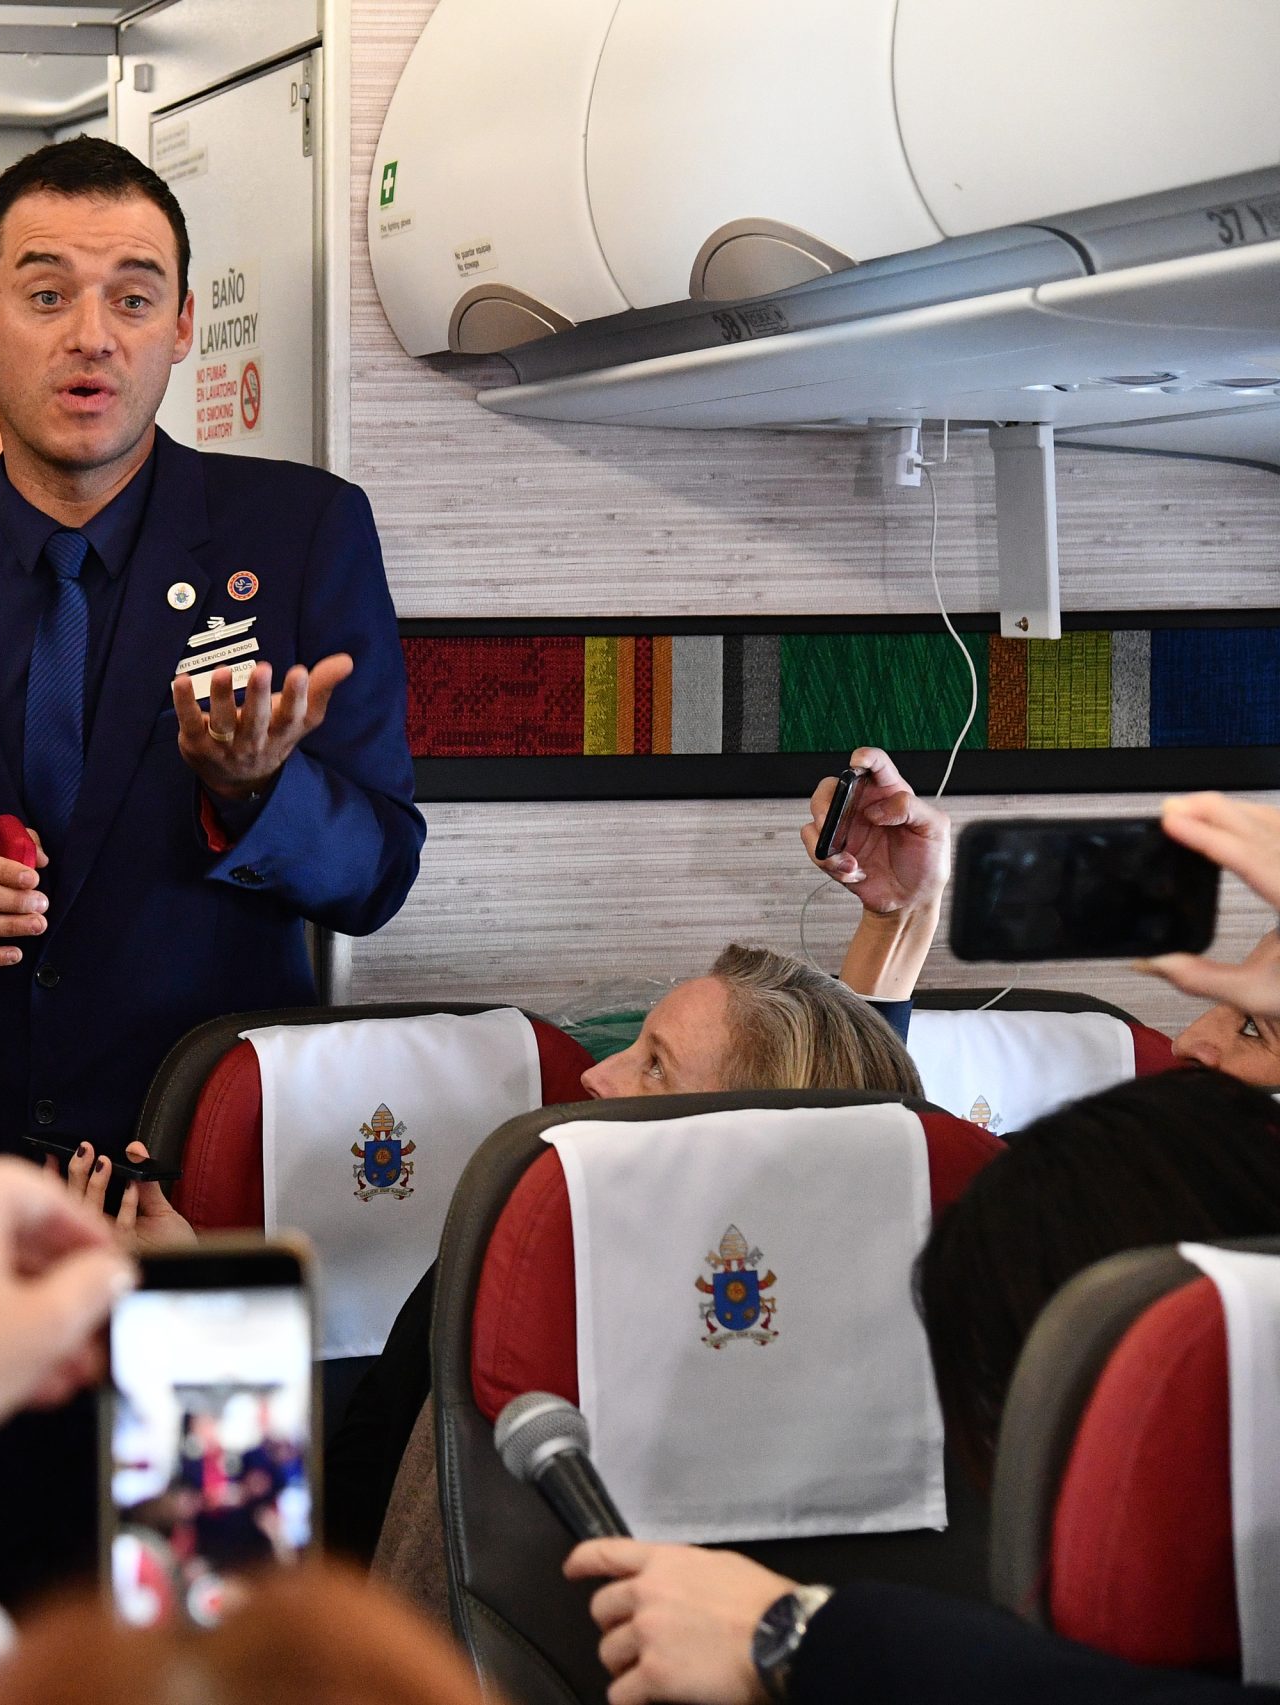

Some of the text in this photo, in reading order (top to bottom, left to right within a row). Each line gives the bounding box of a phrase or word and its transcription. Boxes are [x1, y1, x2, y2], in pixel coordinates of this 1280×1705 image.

[1206, 207, 1245, 245] 37
[212, 267, 244, 310] BAÑO
[200, 312, 258, 355] LAVATORY
[712, 311, 742, 341] 38
[197, 363, 226, 384] NO FUMAR
[197, 380, 237, 402] EN LAVATORIO
[197, 402, 233, 422] NO SMOKING
[197, 421, 233, 441] IN LAVATORY
[179, 662, 191, 670] JEFE
[201, 651, 226, 663] SERVICIO
[233, 643, 253, 653] BORDO
